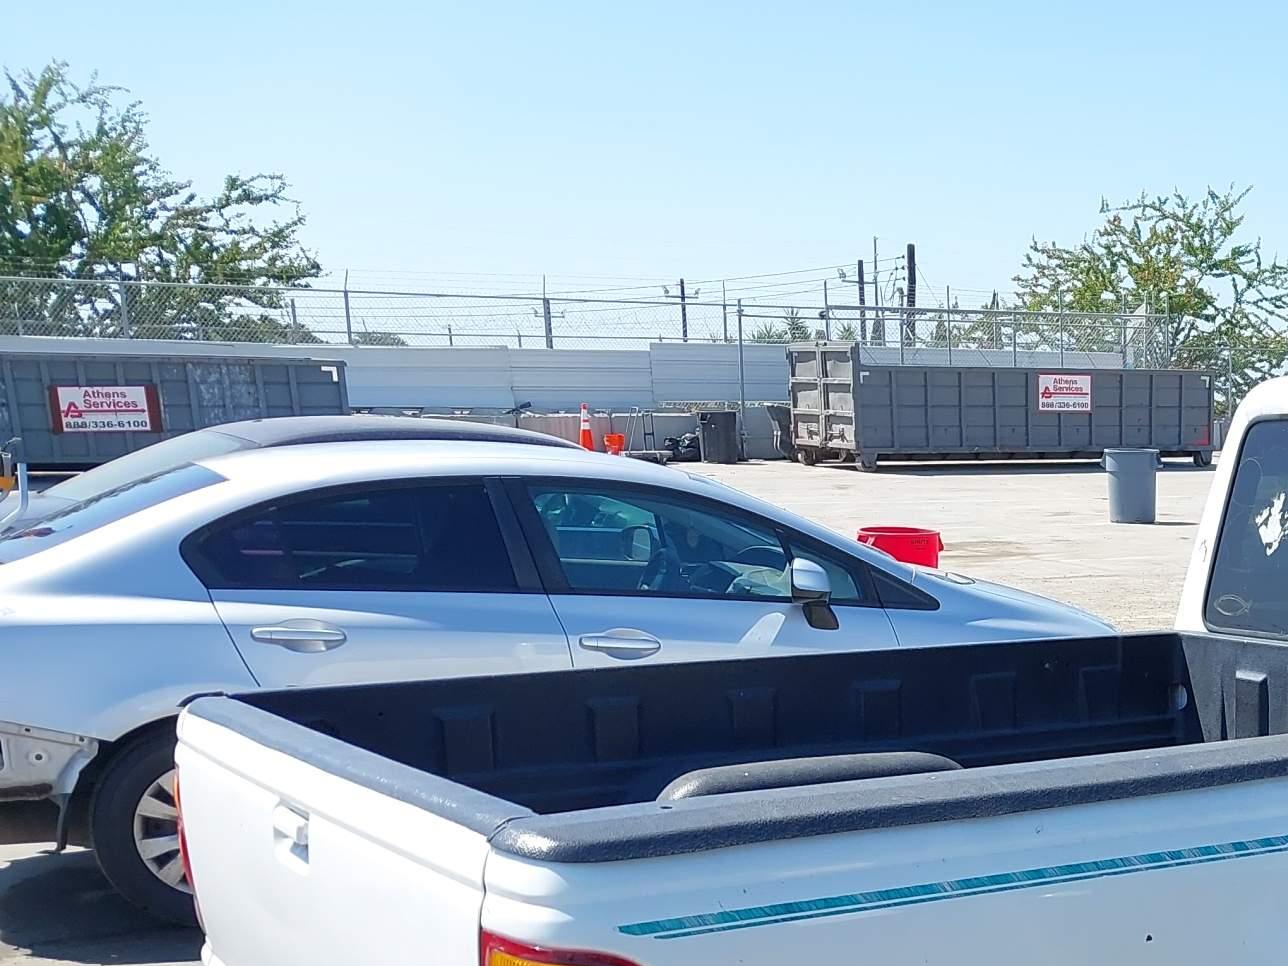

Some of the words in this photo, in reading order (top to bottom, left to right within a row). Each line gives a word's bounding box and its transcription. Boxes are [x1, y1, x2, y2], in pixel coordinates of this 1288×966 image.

[1053, 377, 1078, 385] Athens
[83, 390, 127, 399] Athens
[83, 399, 138, 409] Services
[65, 420, 148, 429] 888/336-6100
